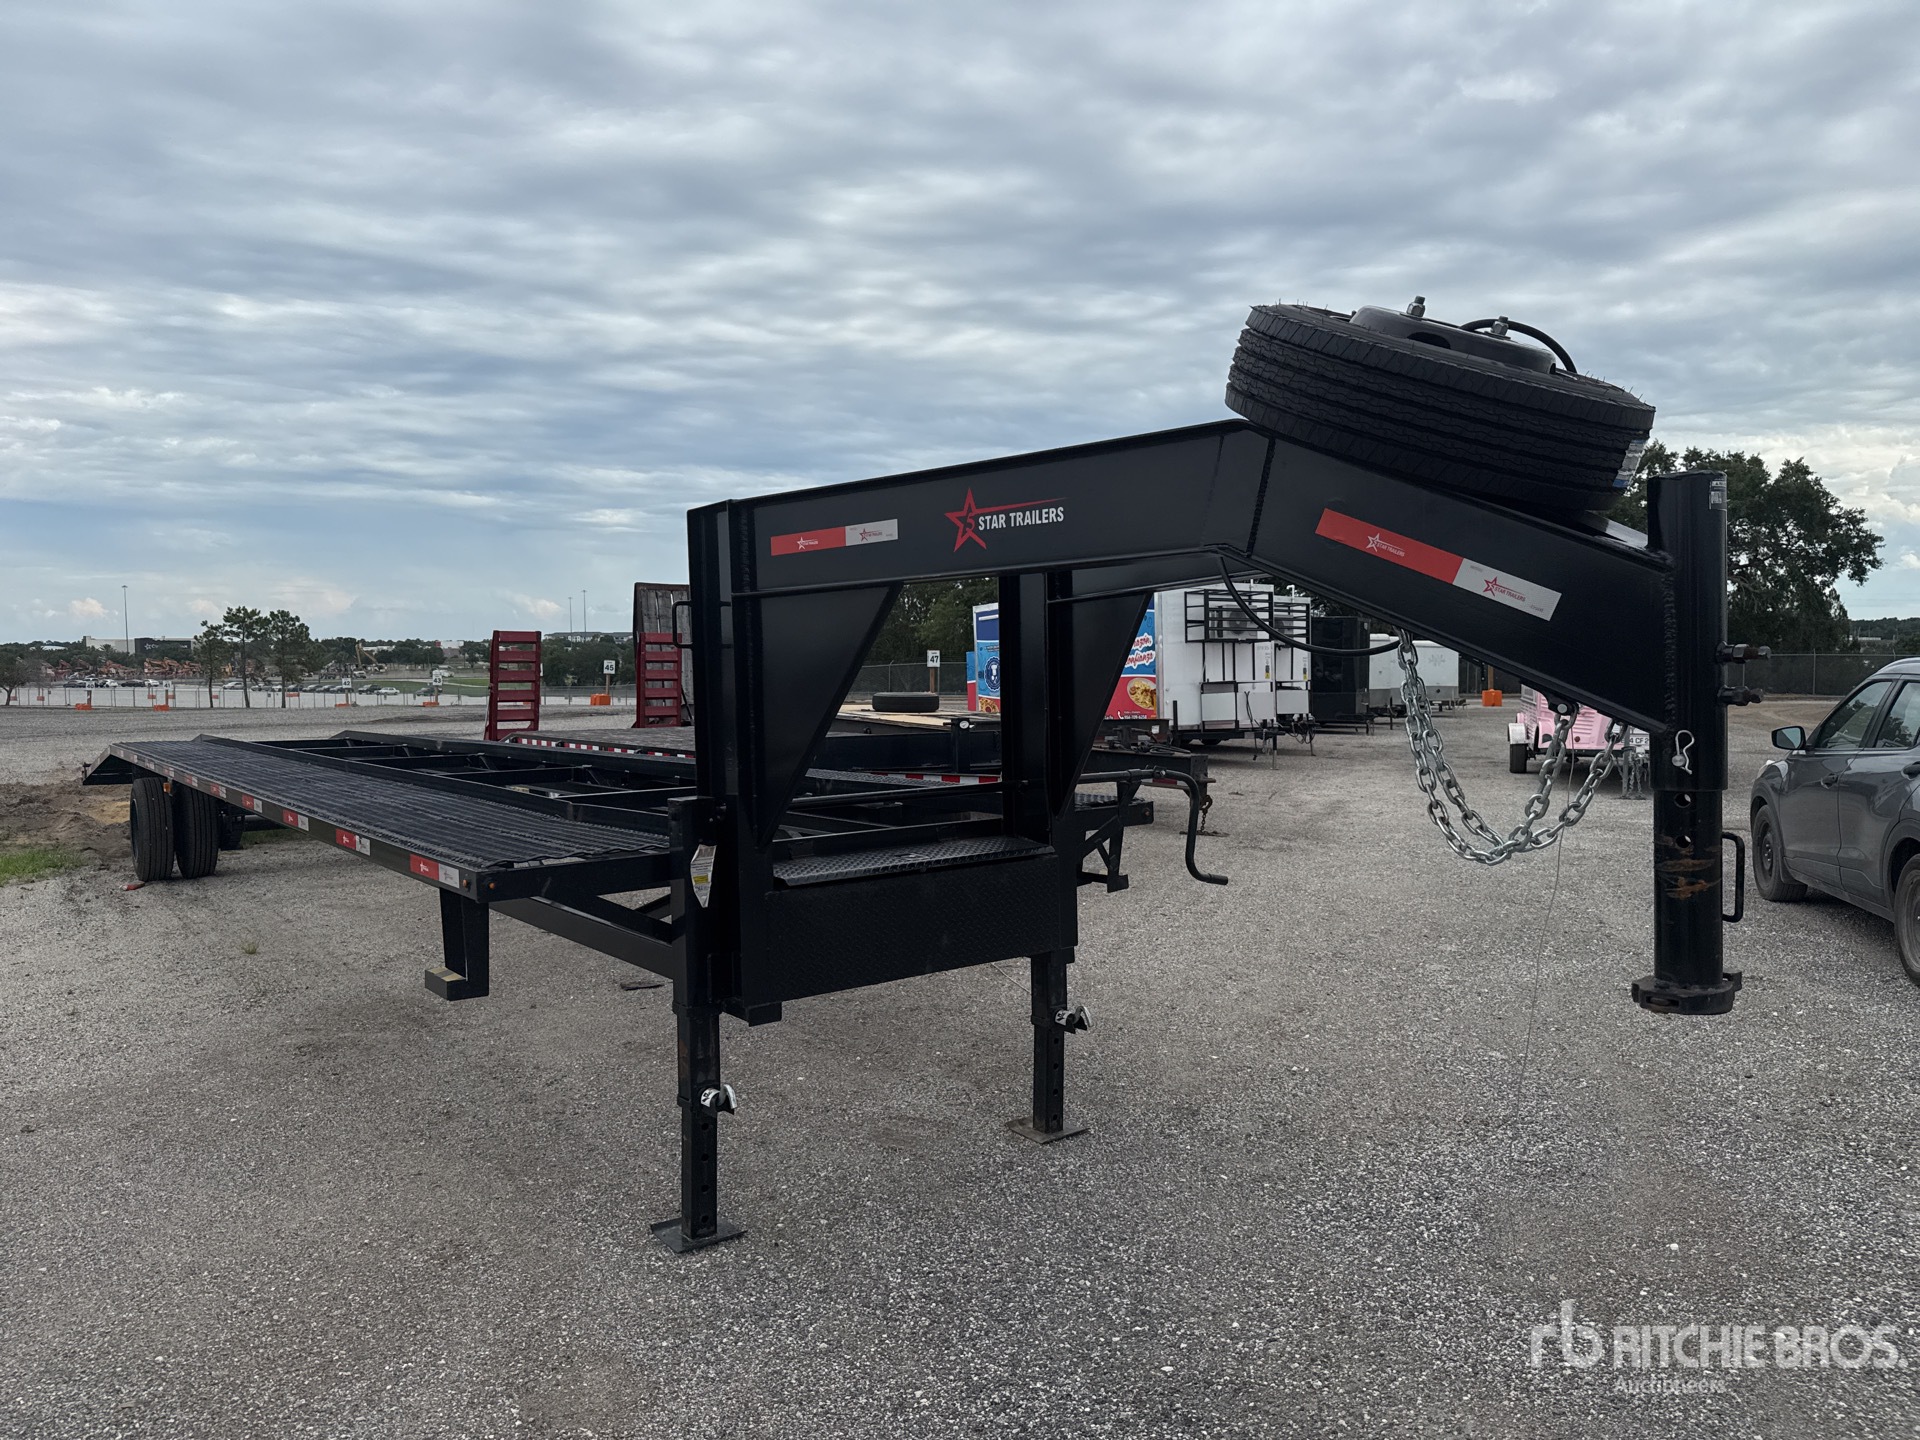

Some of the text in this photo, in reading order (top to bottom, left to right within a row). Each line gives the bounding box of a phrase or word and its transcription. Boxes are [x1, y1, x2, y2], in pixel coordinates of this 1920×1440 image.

[978, 513, 1007, 531] STAR
[1009, 506, 1065, 527] TRAILERS
[1494, 585, 1506, 596] STAR
[1505, 590, 1526, 602] TRAILERS
[930, 655, 939, 664] 47
